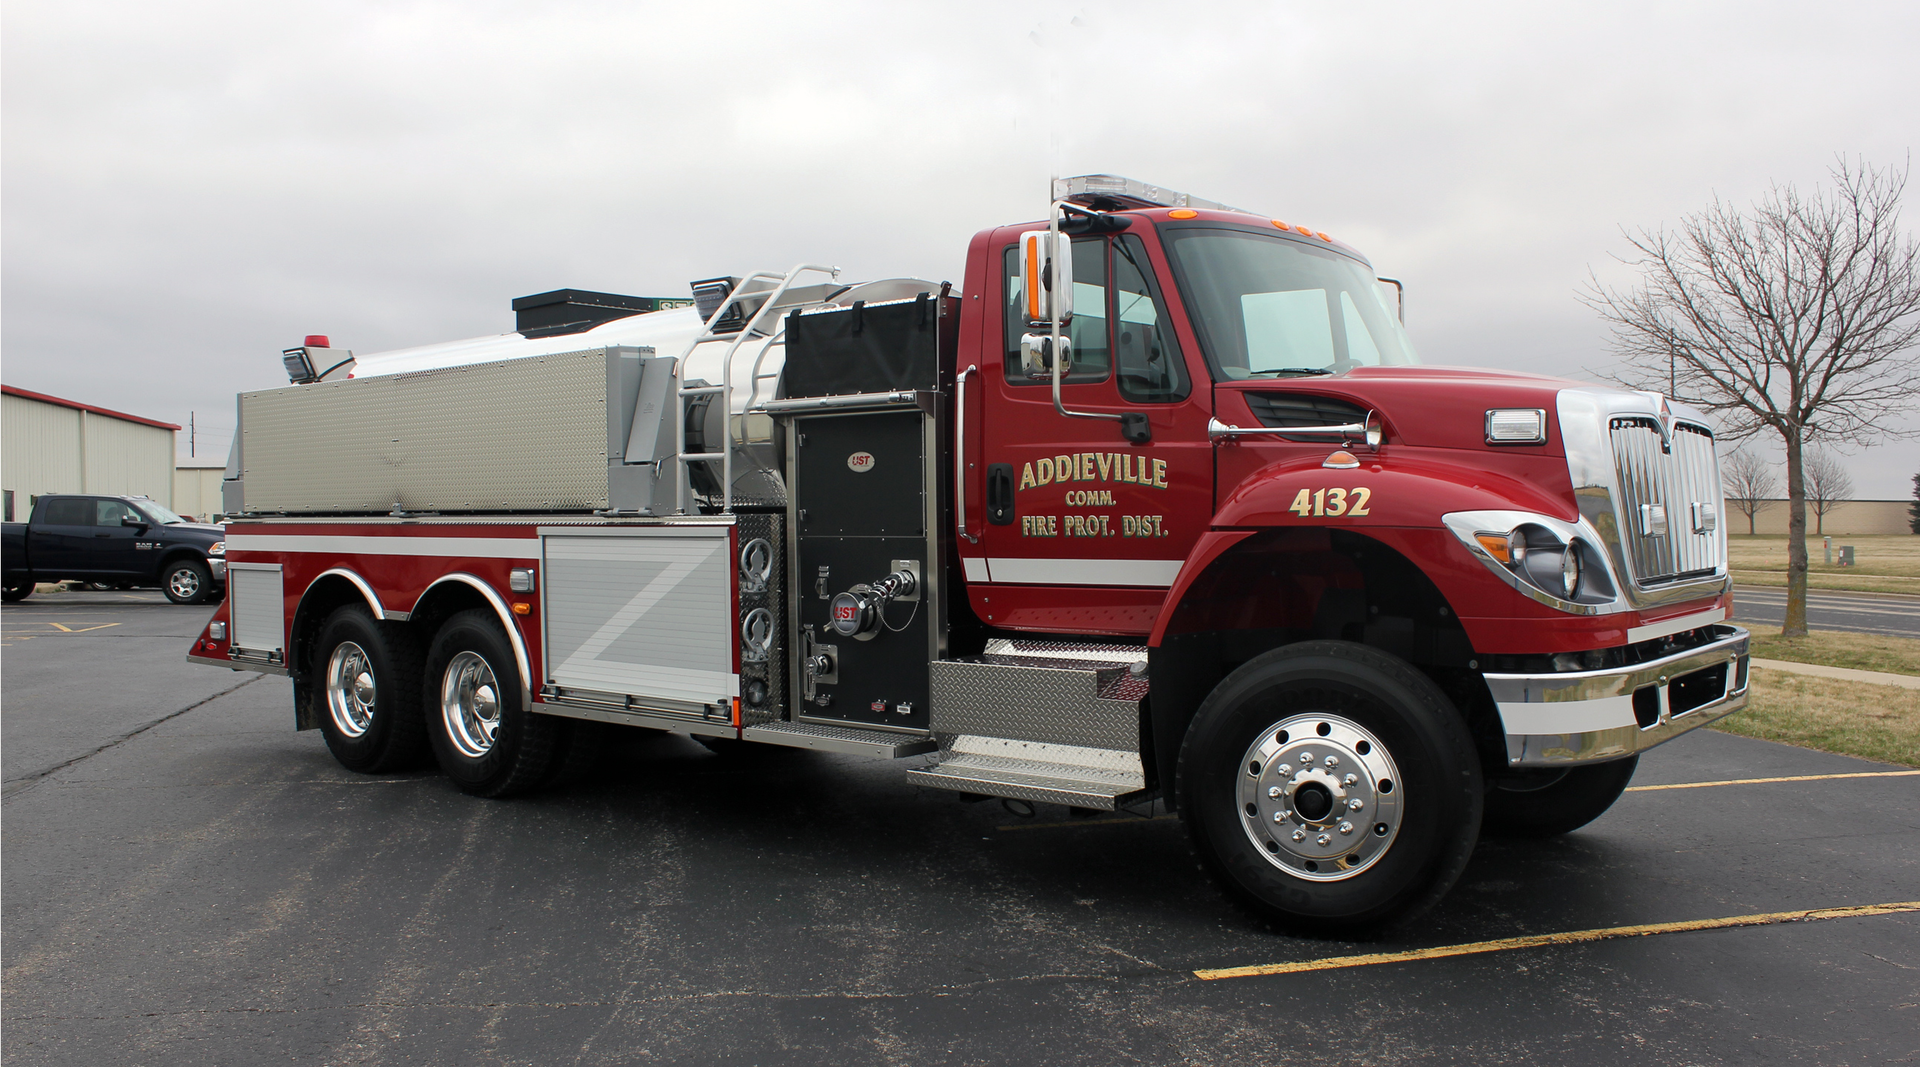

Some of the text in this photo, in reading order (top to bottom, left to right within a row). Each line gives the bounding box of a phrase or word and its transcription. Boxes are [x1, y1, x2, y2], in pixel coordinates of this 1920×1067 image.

[1019, 453, 1168, 491] ADDIEVILLE
[1065, 490, 1116, 506] COMM.
[1288, 487, 1371, 517] 4132
[1022, 515, 1168, 537] FIRE PROT. DIST.
[834, 606, 857, 619] UST
